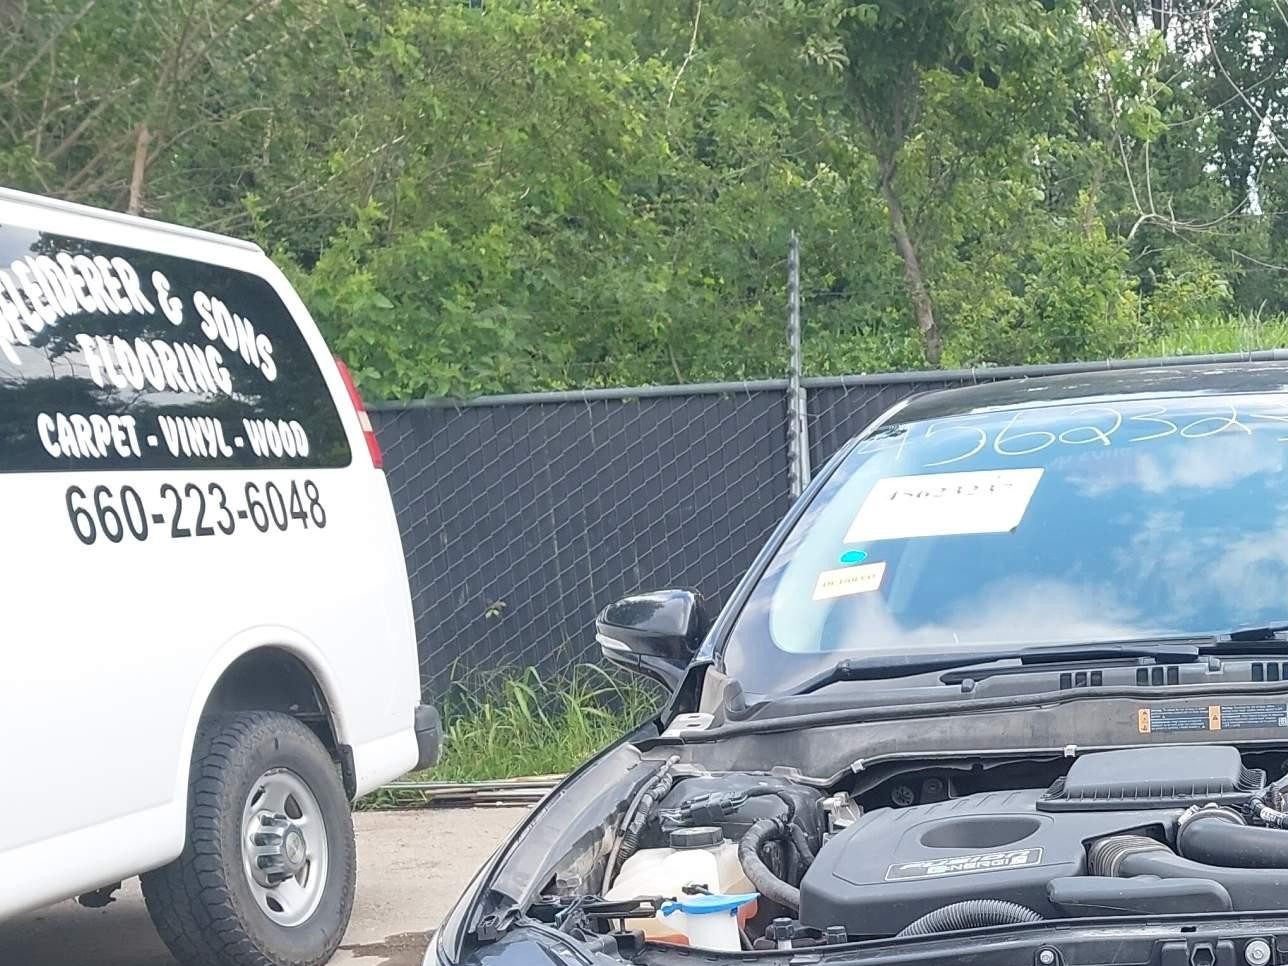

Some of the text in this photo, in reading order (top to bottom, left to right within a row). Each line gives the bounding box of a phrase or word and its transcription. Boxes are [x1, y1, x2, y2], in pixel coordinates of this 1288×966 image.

[151, 270, 183, 326] &
[193, 290, 278, 382] SONS
[75, 333, 233, 394] FLOORING
[37, 412, 141, 458] CARPET
[158, 415, 233, 457] VINYL
[243, 418, 309, 458] WOOD
[65, 479, 326, 545] 660-223-6048
